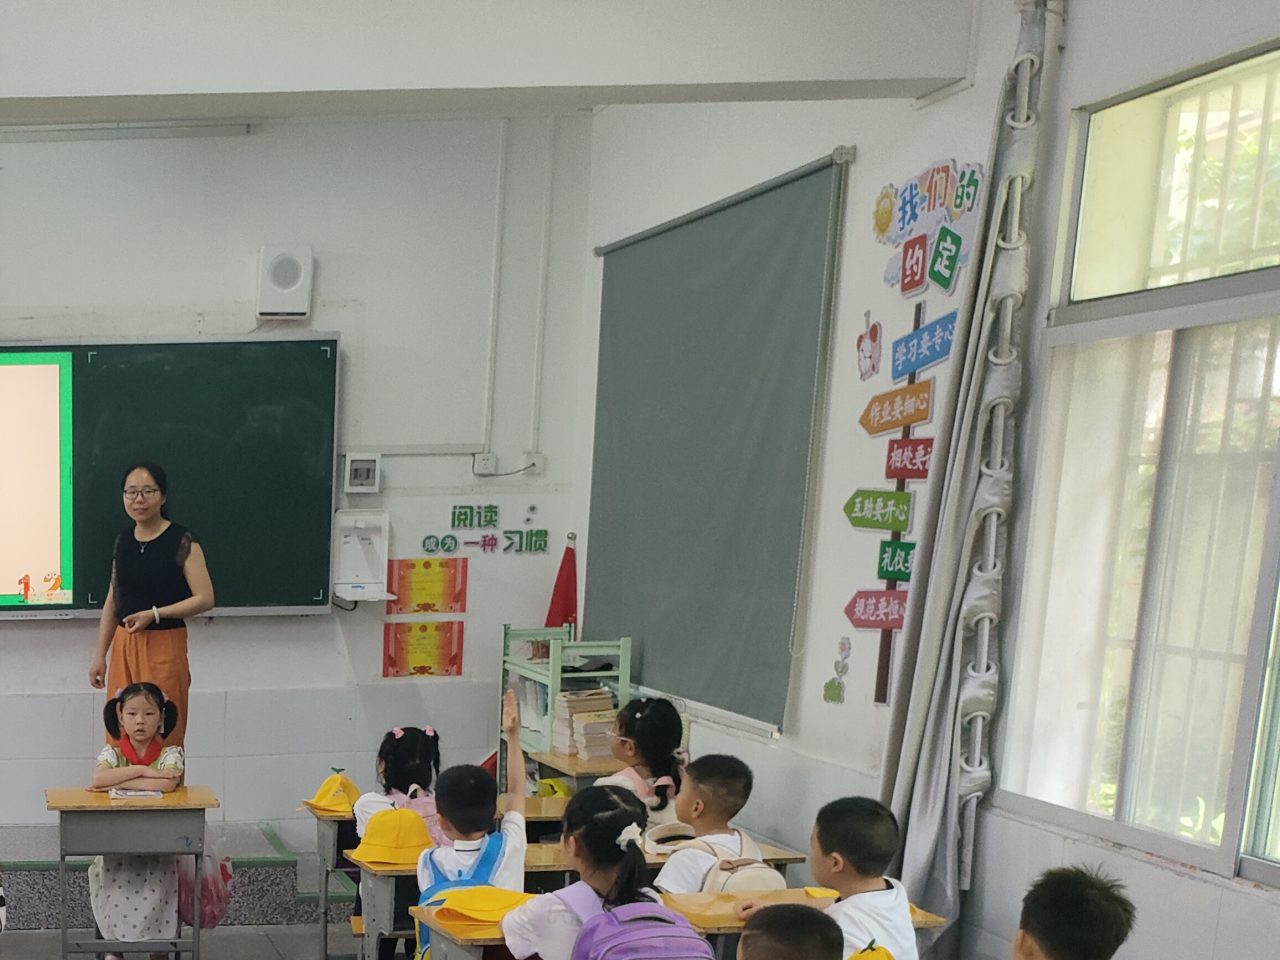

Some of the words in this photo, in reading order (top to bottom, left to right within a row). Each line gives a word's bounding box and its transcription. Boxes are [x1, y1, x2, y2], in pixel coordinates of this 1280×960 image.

[898, 165, 979, 232] 我们的
[904, 235, 956, 284] 约定
[895, 323, 956, 370] 学习要专心
[869, 392, 929, 427] 作业要细心
[451, 504, 498, 529] 阅读
